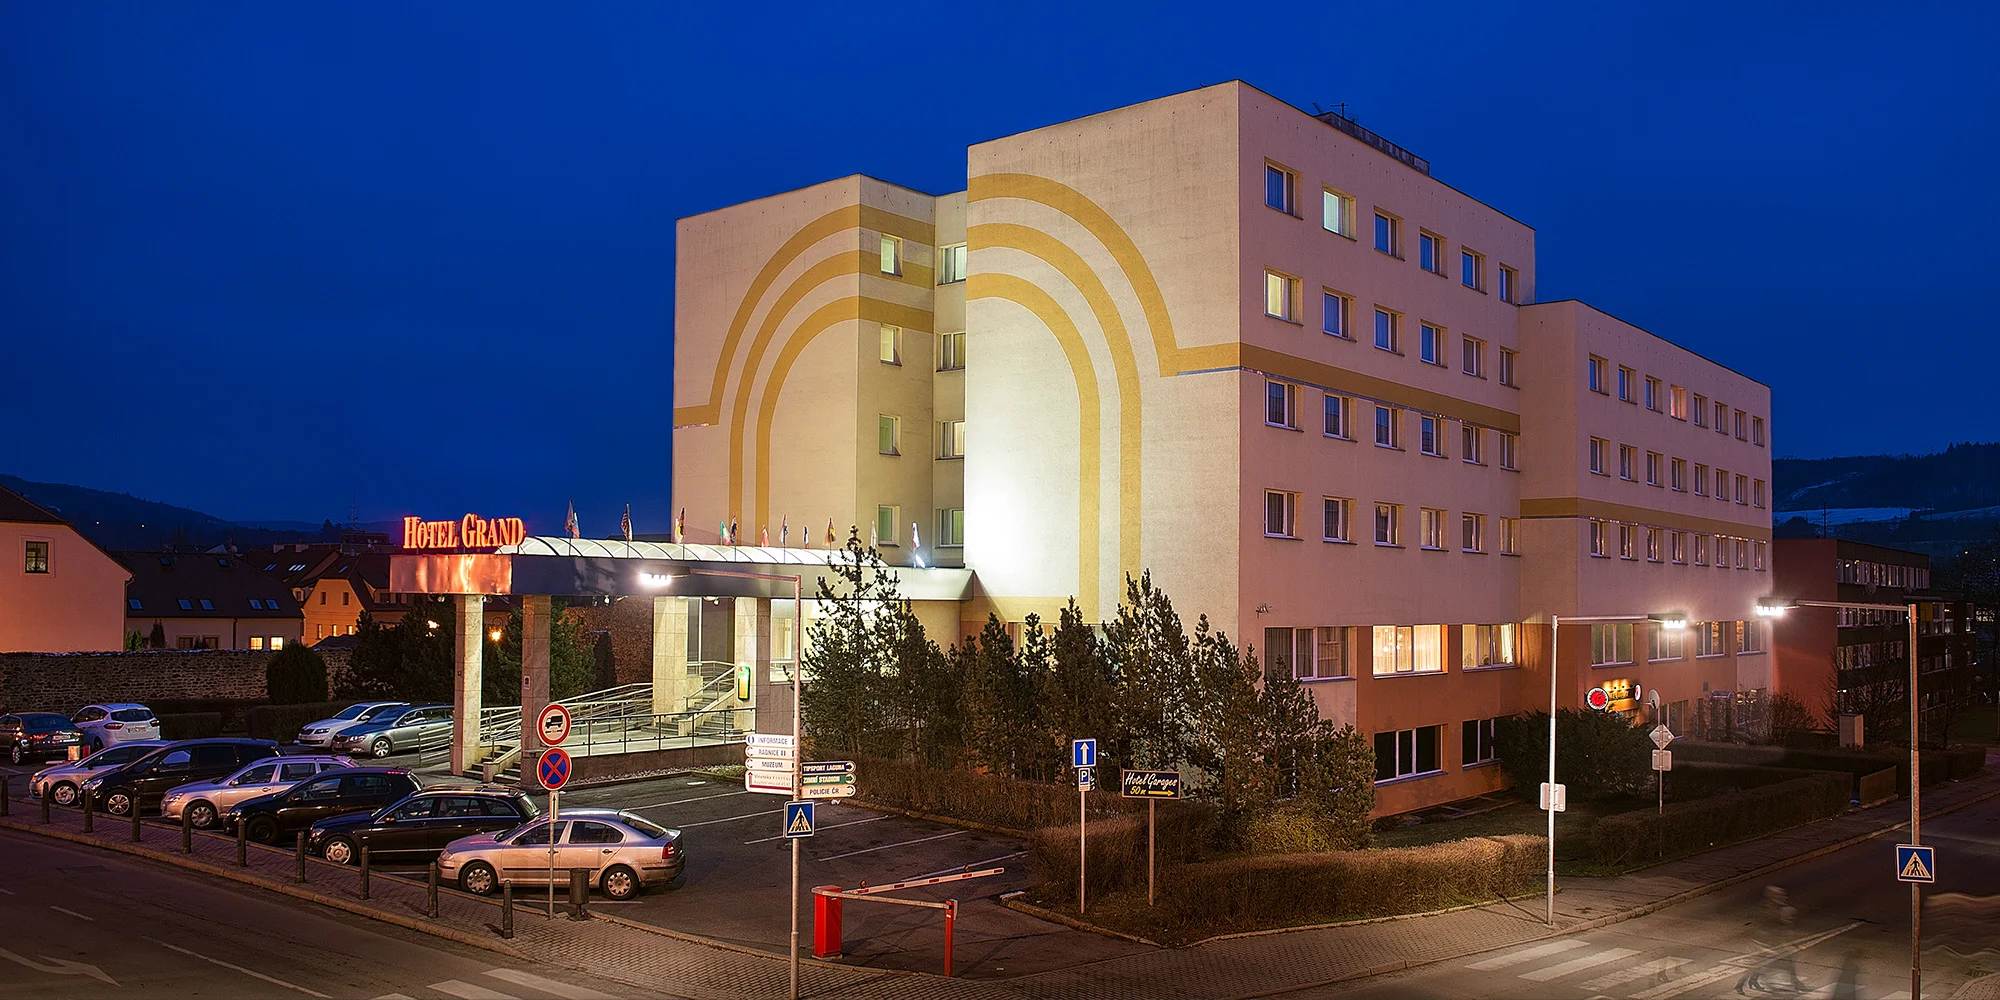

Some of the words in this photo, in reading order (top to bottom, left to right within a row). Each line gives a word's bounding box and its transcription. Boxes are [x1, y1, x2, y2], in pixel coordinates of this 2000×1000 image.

[403, 516, 459, 549] HOTEL
[462, 513, 524, 548] GRAND
[1081, 770, 1087, 781] P
[1125, 772, 1148, 785] Hotel
[1148, 773, 1178, 790] Garages
[1130, 785, 1140, 795] 50
